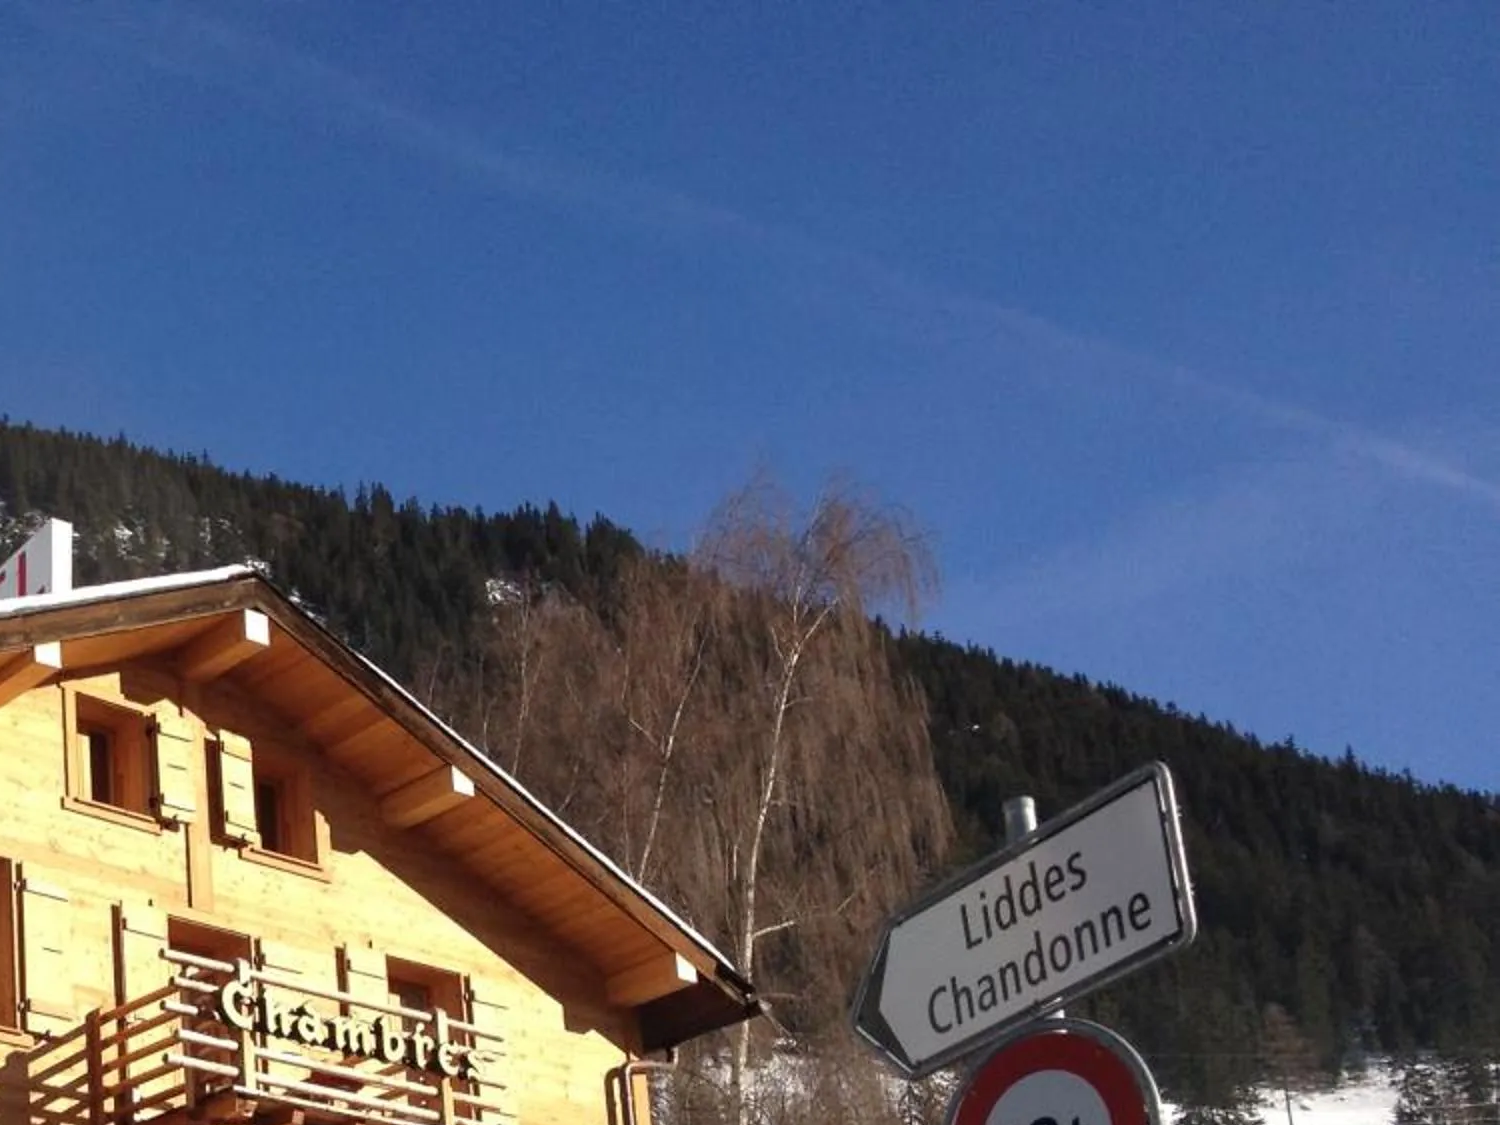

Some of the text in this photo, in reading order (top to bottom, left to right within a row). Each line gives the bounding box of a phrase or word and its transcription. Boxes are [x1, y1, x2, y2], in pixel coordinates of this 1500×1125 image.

[960, 851, 1088, 949] Liddes
[928, 891, 1153, 1033] Chandonne
[221, 979, 490, 1080] Chambres
